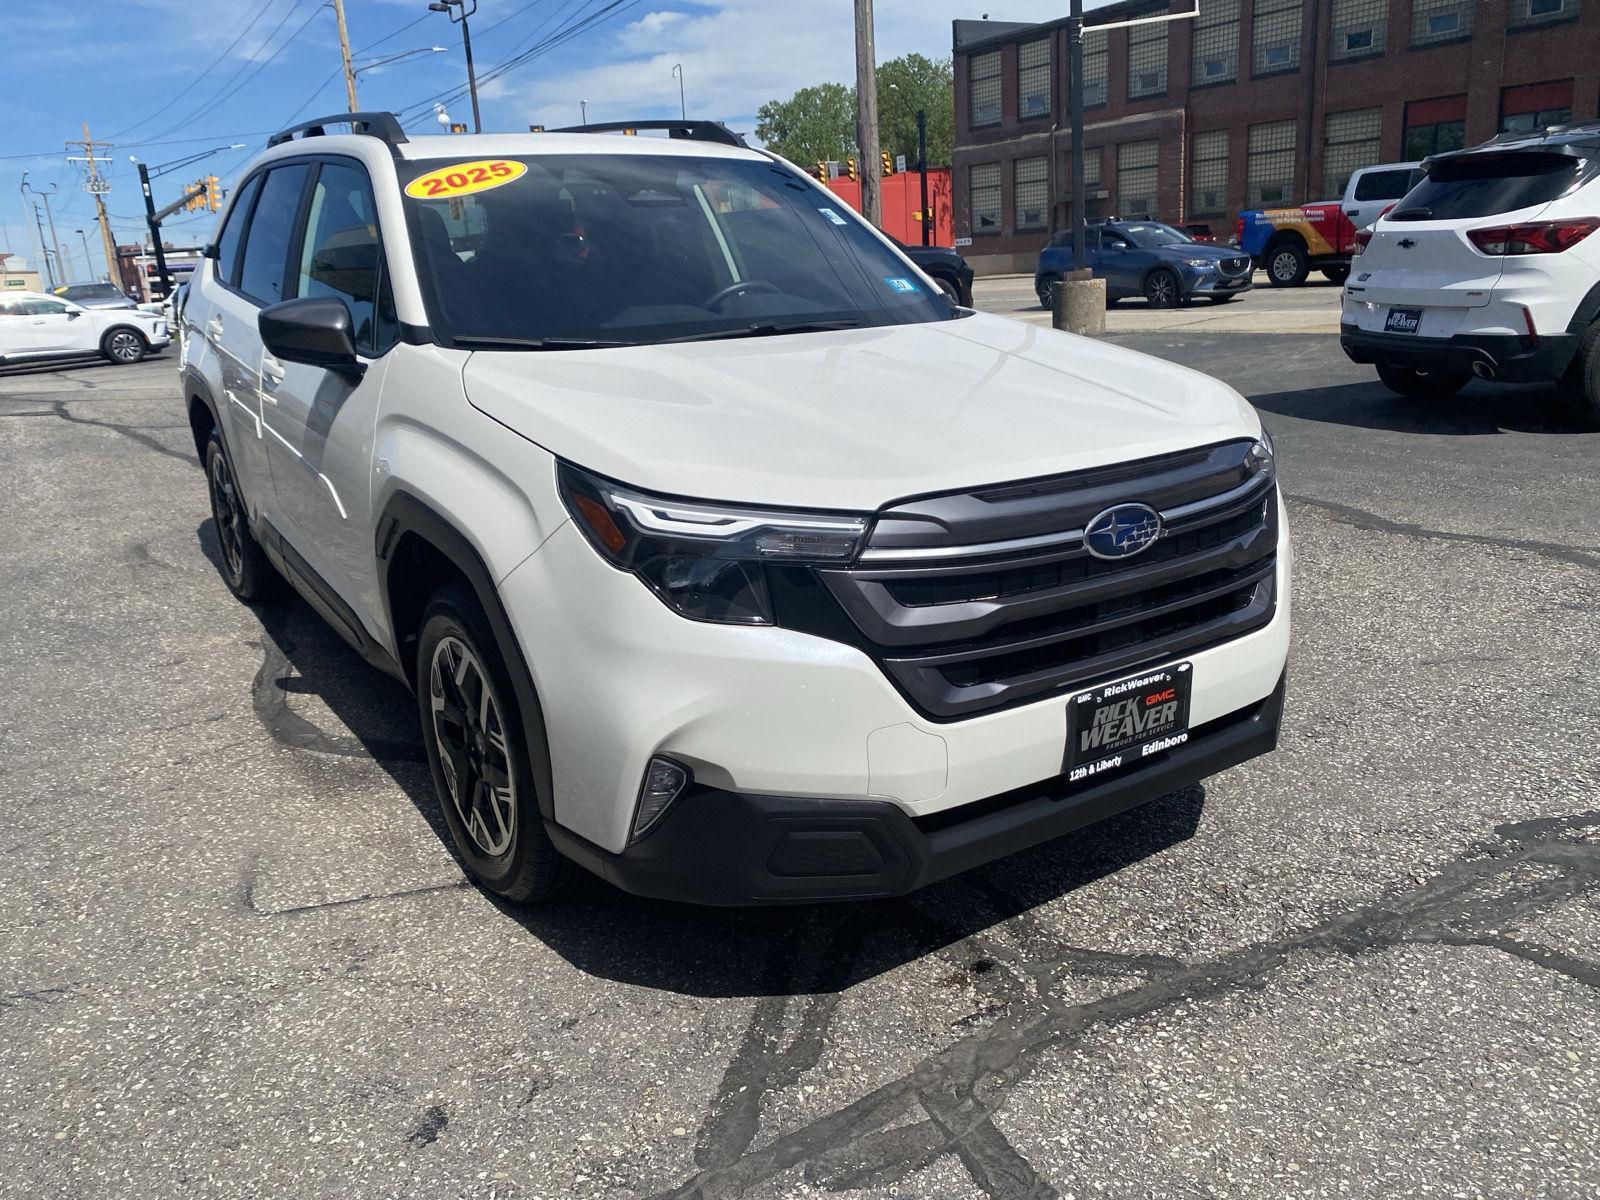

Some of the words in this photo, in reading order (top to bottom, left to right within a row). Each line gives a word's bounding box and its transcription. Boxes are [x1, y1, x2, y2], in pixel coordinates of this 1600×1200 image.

[422, 162, 512, 195] 2025
[1387, 317, 1418, 328] WEAVER
[1104, 673, 1165, 697] RickWeaver
[1145, 688, 1175, 705] GMC
[1077, 693, 1092, 703] GMC
[1093, 696, 1141, 727] RICK
[1081, 700, 1177, 752] WEAVER
[1142, 733, 1188, 756] Edinboro
[1069, 766, 1088, 781] 12th
[1088, 763, 1096, 776] &
[1096, 756, 1122, 771] Liberty
